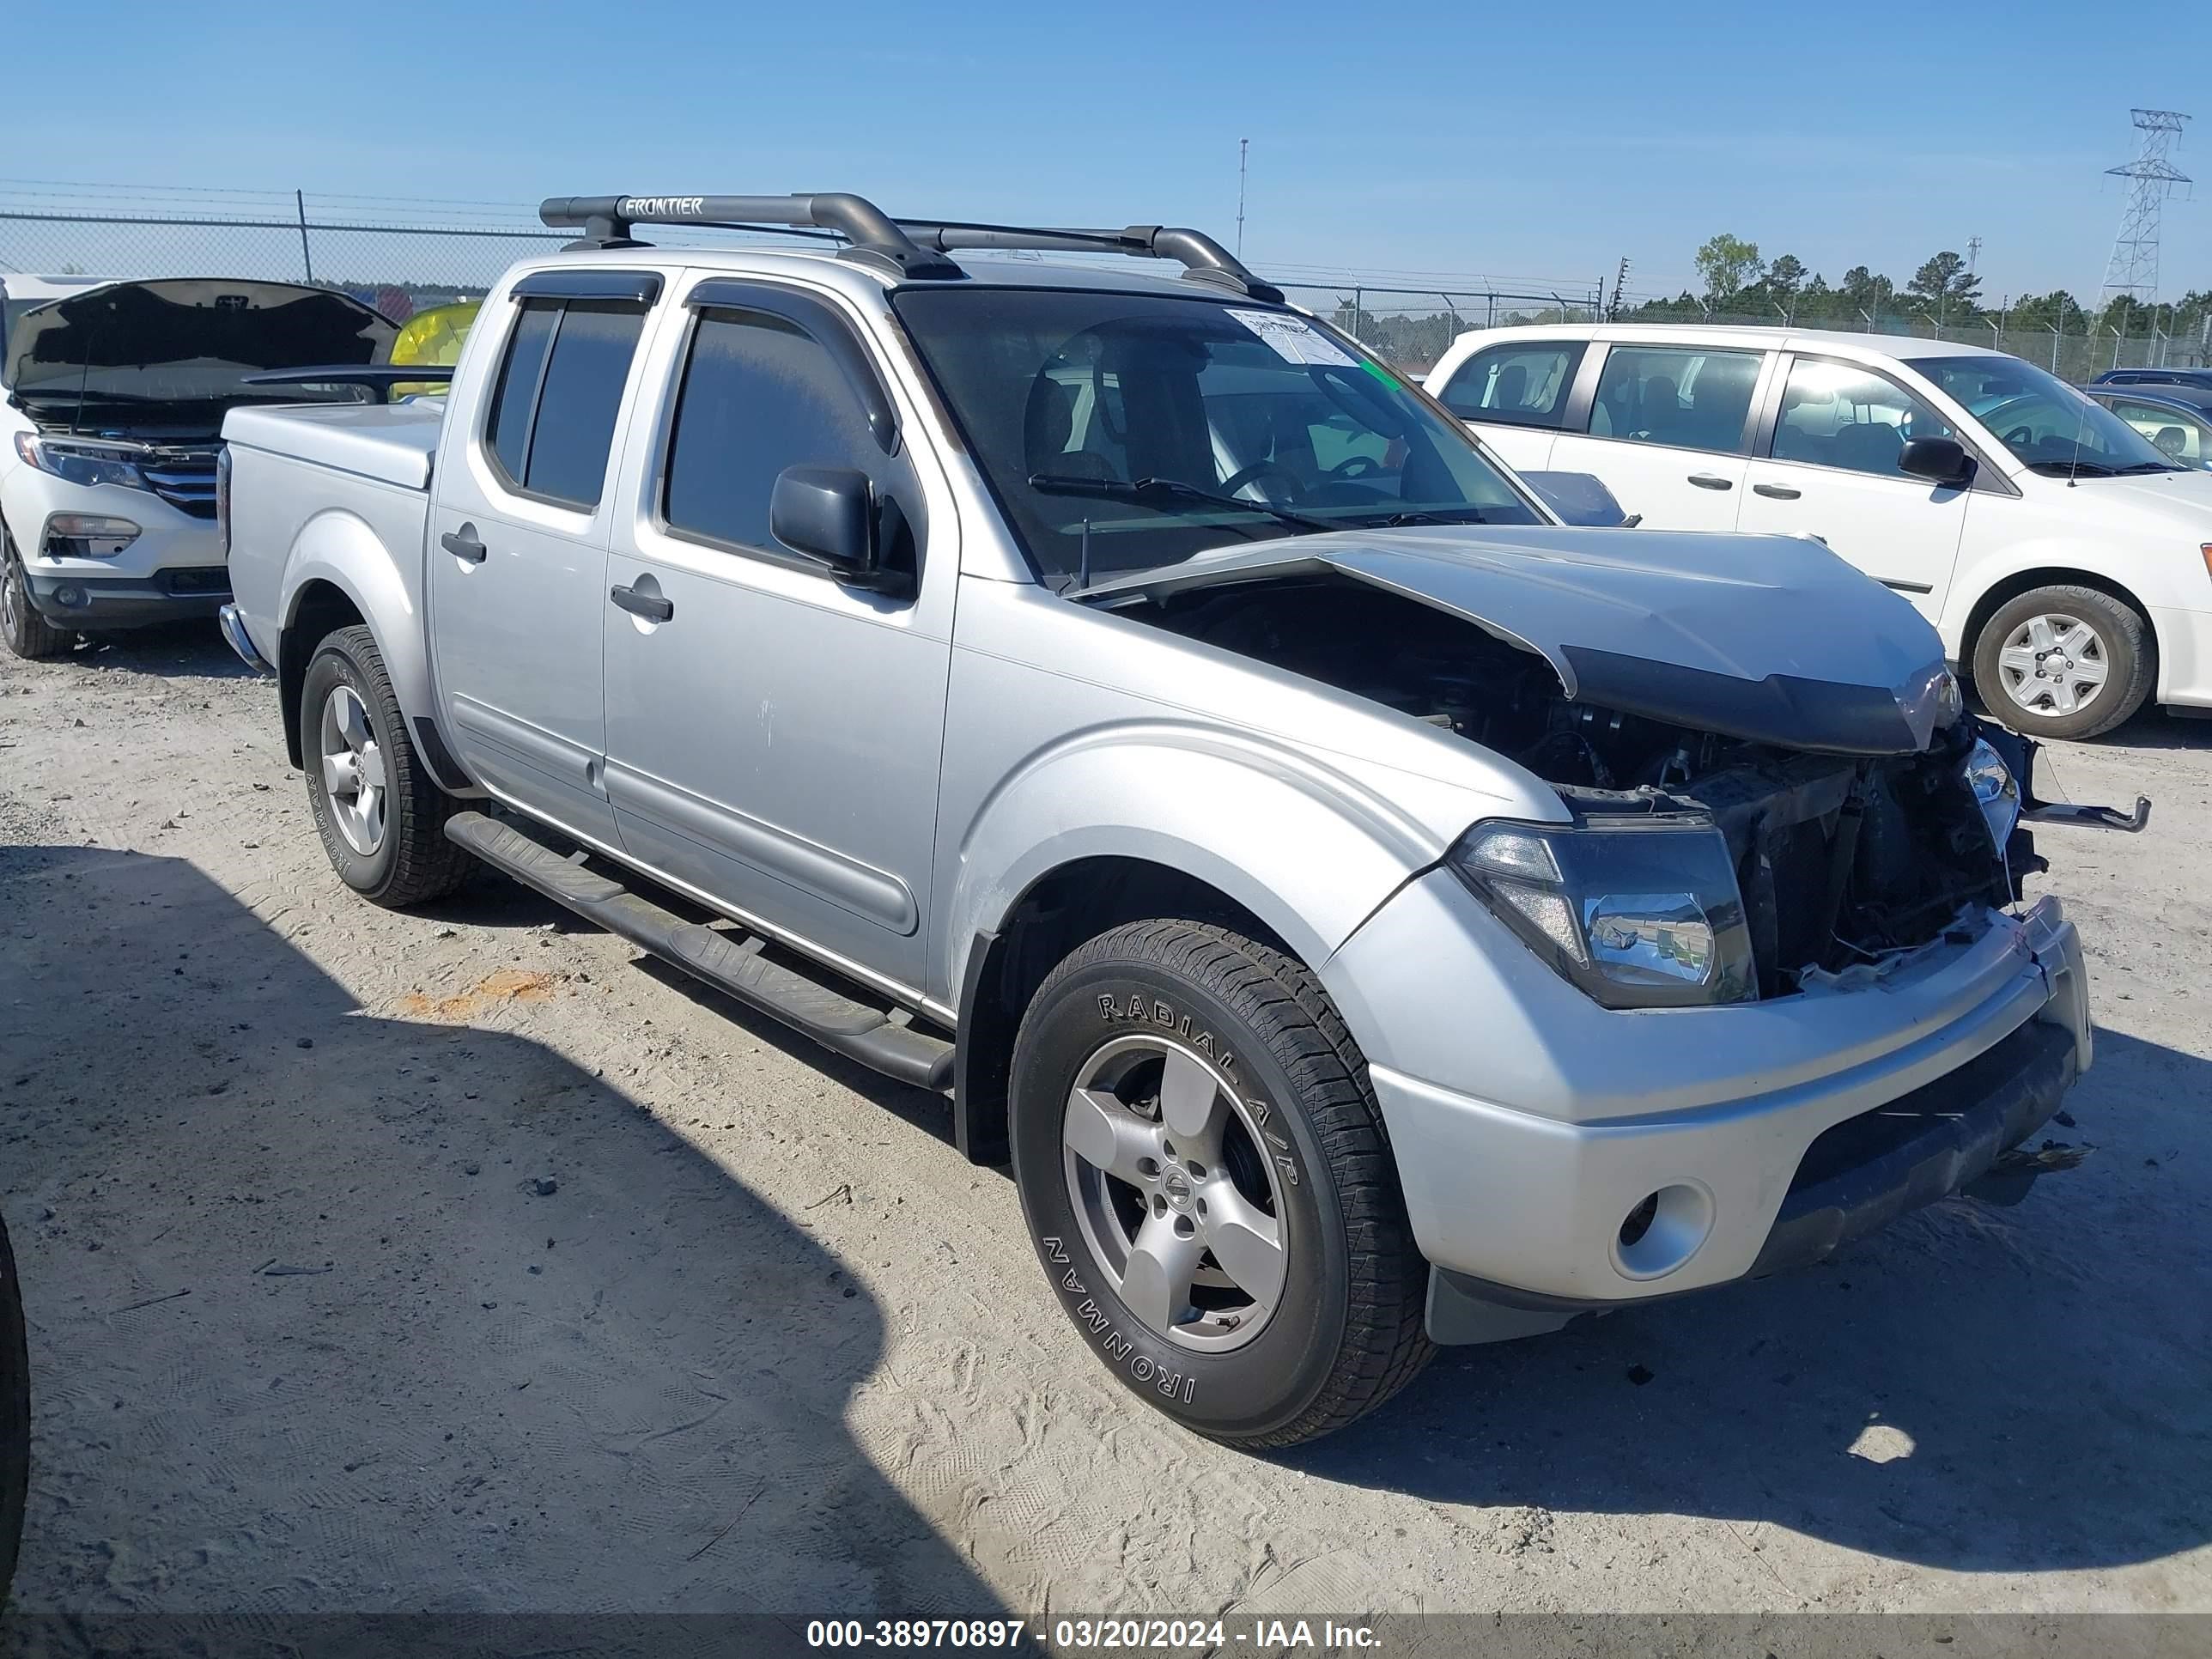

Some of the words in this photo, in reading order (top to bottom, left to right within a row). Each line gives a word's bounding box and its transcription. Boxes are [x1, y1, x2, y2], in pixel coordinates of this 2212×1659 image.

[625, 197, 704, 216] FRONTIER
[307, 774, 351, 875] IRONMAN
[1097, 993, 1240, 1085] RADIAL
[1246, 1097, 1299, 1186] A/P
[1042, 1237, 1196, 1405] IRONMAN
